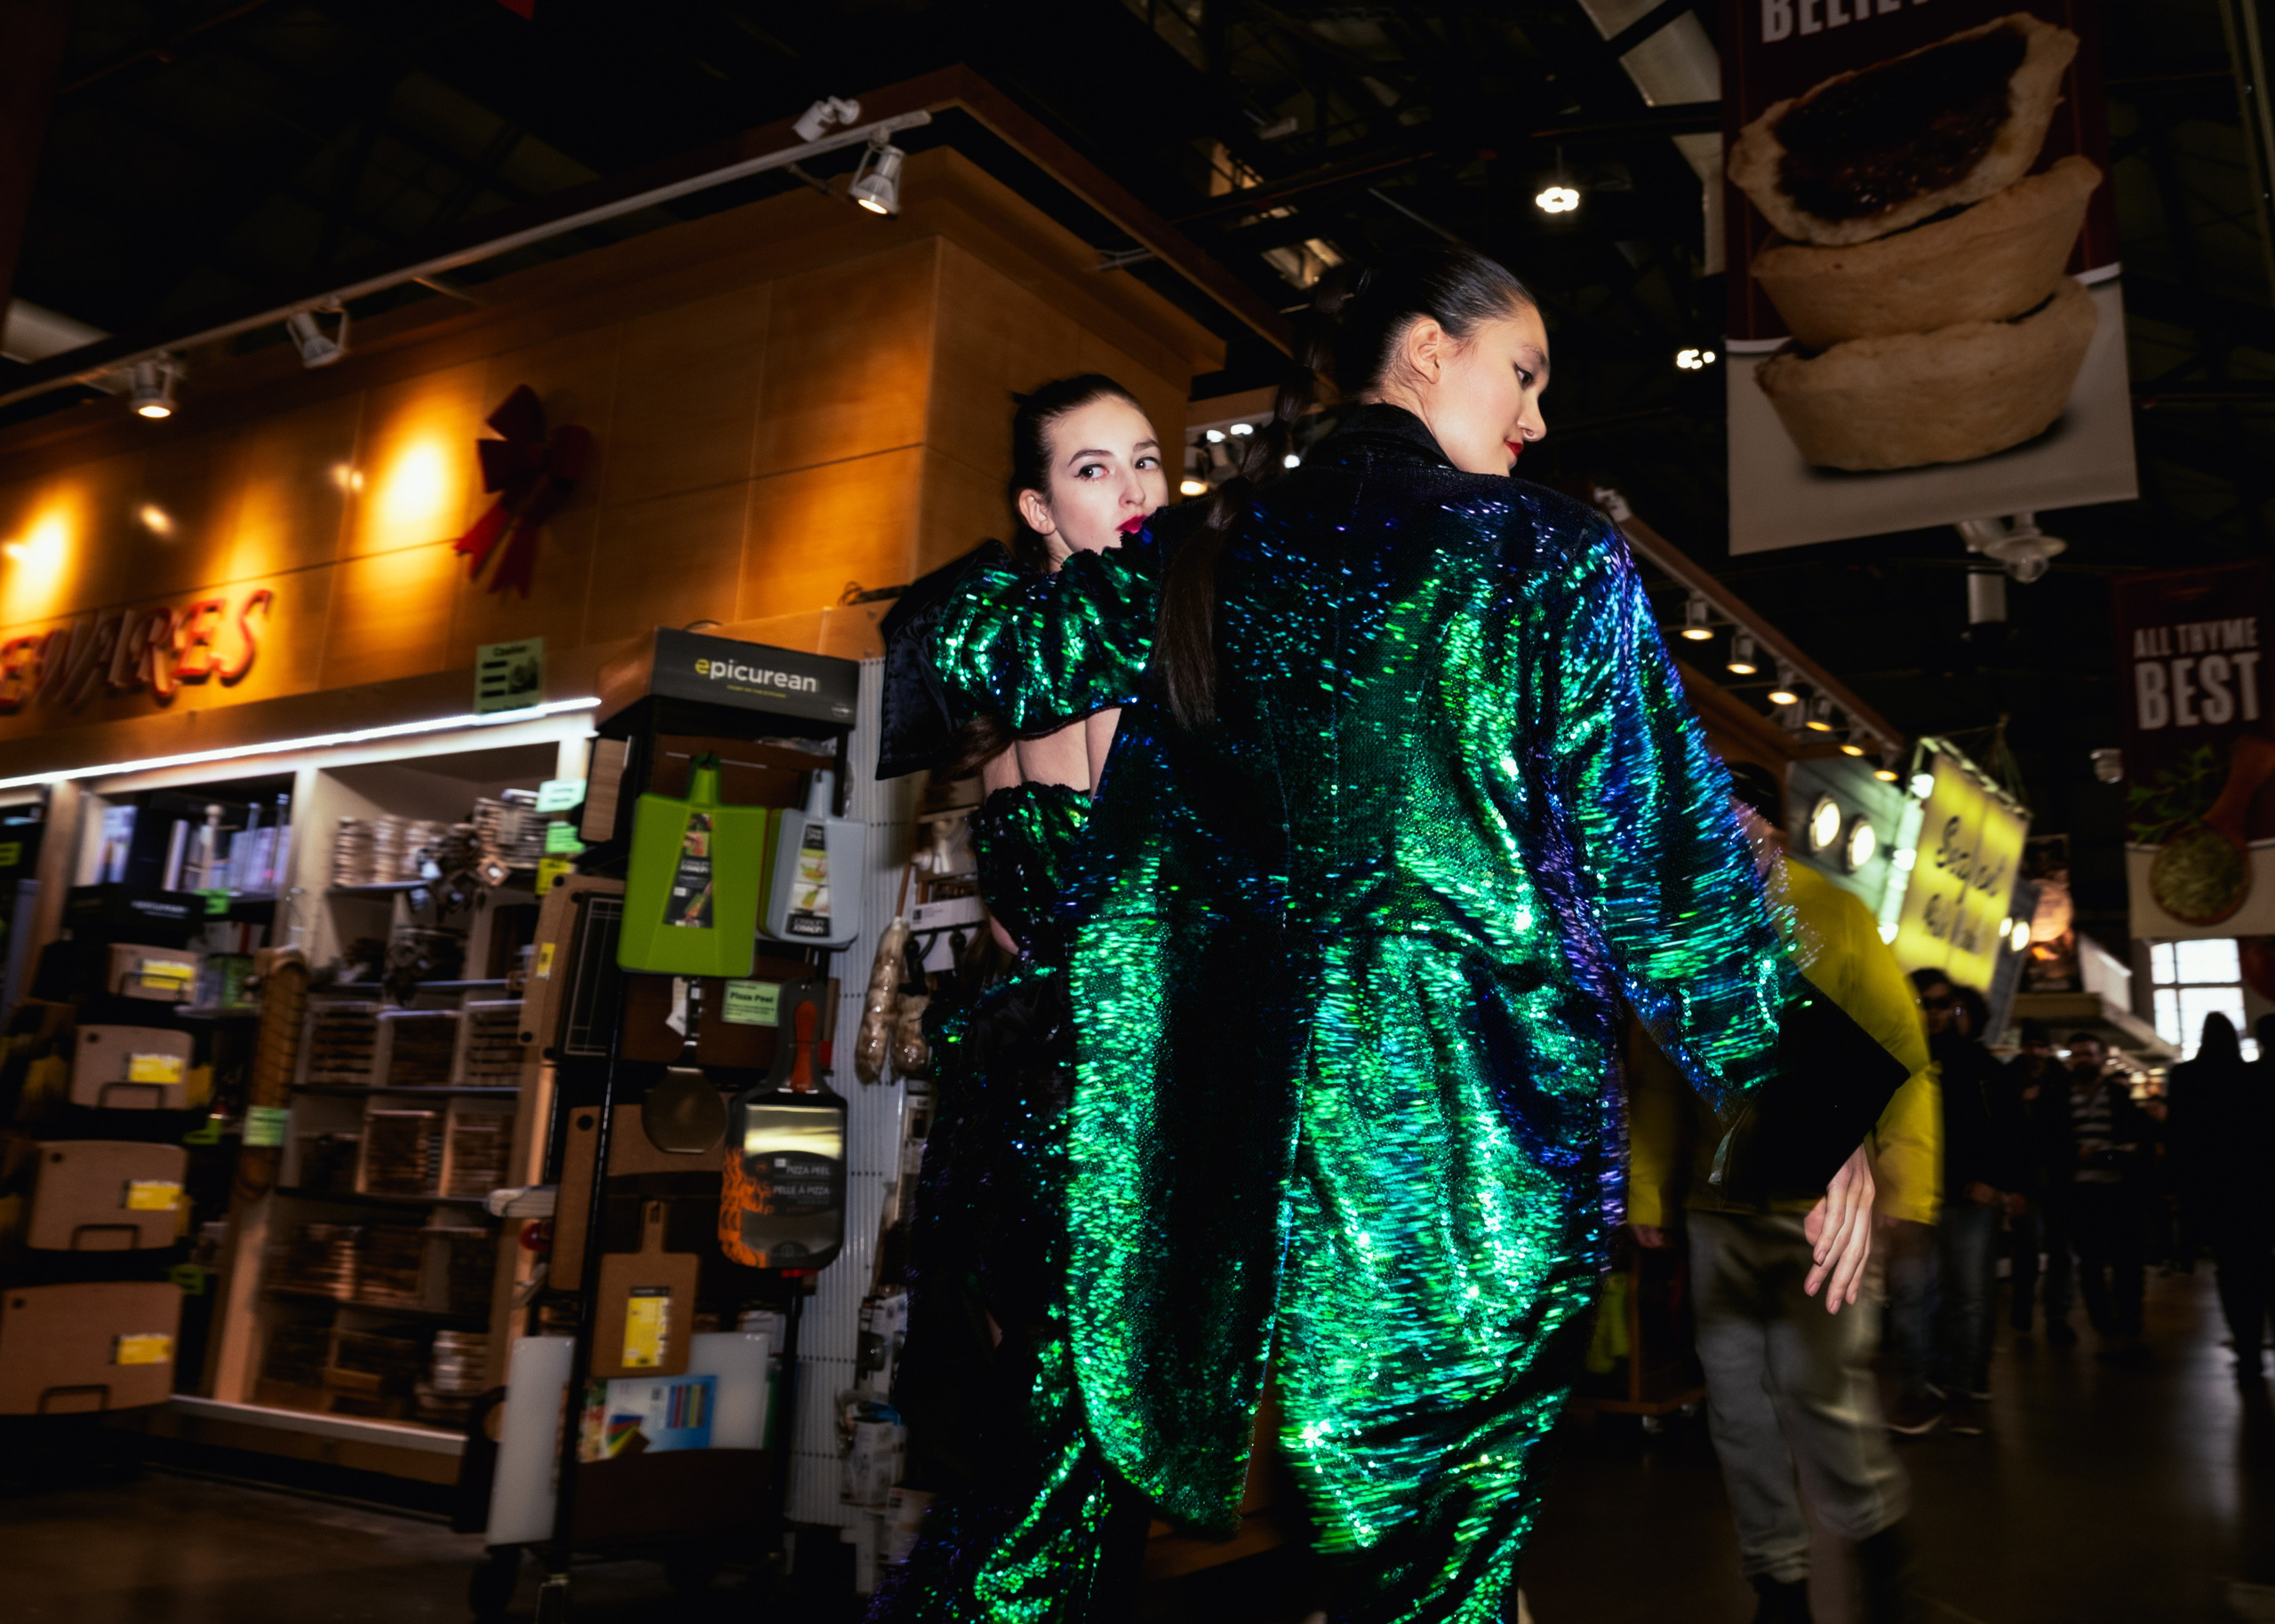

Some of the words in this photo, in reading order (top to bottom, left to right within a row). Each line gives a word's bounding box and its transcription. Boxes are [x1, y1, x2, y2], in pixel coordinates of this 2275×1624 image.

[2133, 625, 2173, 659] ALL
[2175, 616, 2260, 656] THYME
[694, 658, 820, 692] epicurean
[2134, 650, 2262, 730] BEST
[786, 1165, 809, 1175] PIZZA
[810, 1166, 831, 1176] PEEL
